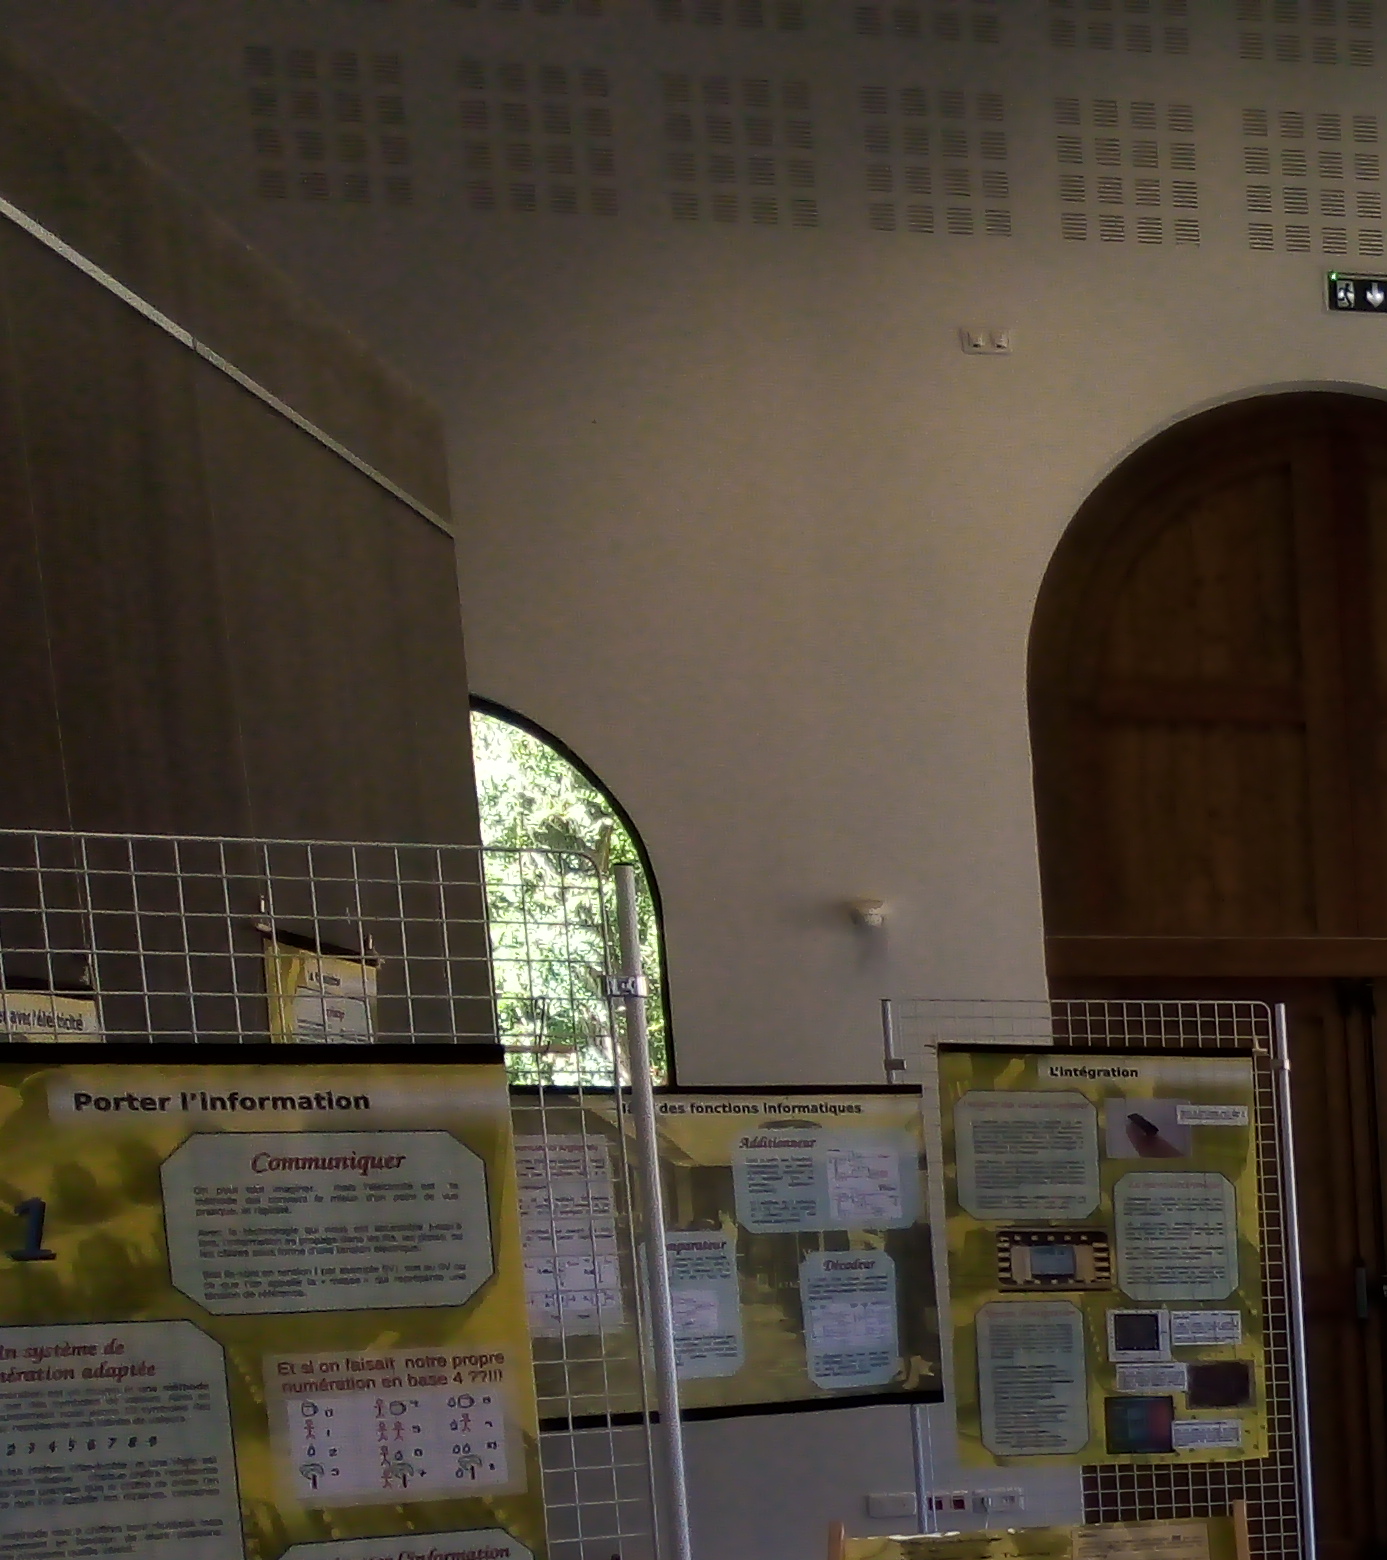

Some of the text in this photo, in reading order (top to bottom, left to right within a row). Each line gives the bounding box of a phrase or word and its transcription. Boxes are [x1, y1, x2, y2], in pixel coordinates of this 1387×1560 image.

[1049, 1065, 1140, 1080] L'intégration
[73, 1091, 170, 1113] Porter
[660, 1103, 687, 1115] des
[690, 1102, 760, 1115] fonctions
[739, 1135, 817, 1151] Additionneur
[251, 1152, 407, 1176] Communiquer
[5, 1197, 57, 1261] 1
[22, 1341, 98, 1364] système
[103, 1338, 125, 1355] de
[82, 1361, 156, 1383] adaptée
[277, 1361, 296, 1376] Et
[301, 1359, 315, 1374] si
[320, 1361, 340, 1374] on
[405, 1356, 447, 1369] notre
[452, 1351, 505, 1371] propre
[281, 1374, 376, 1393] numération
[381, 1375, 403, 1388] en
[407, 1372, 448, 1387] base
[452, 1371, 464, 1384] 4
